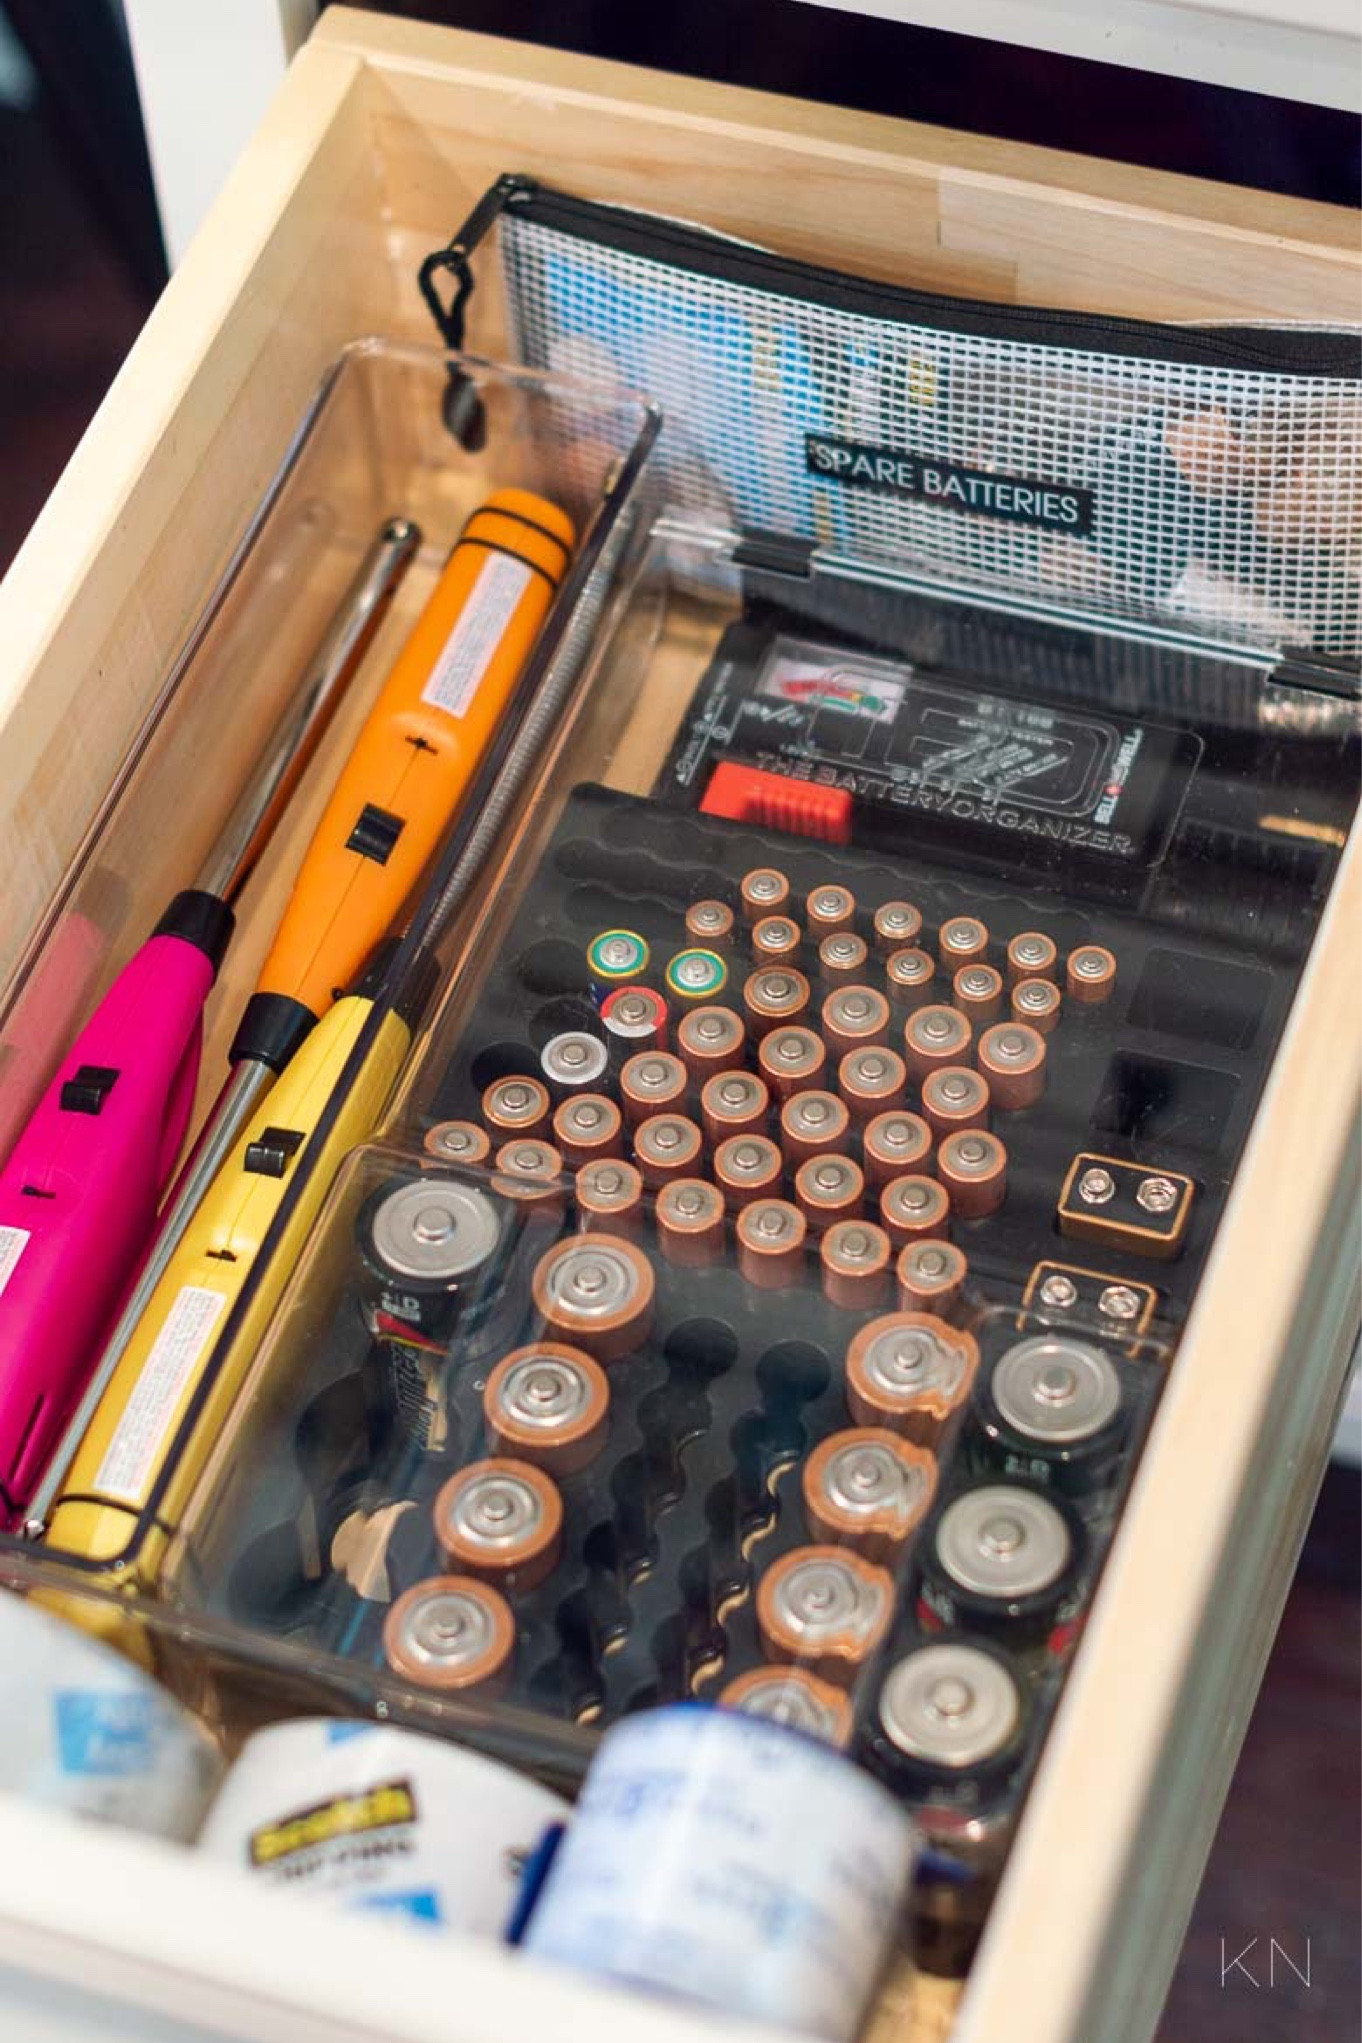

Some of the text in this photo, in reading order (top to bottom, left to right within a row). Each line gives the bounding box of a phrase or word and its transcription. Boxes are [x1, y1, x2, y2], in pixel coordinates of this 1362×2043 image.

[815, 443, 1079, 523] SPARE BATTERIES
[756, 750, 802, 780] THE
